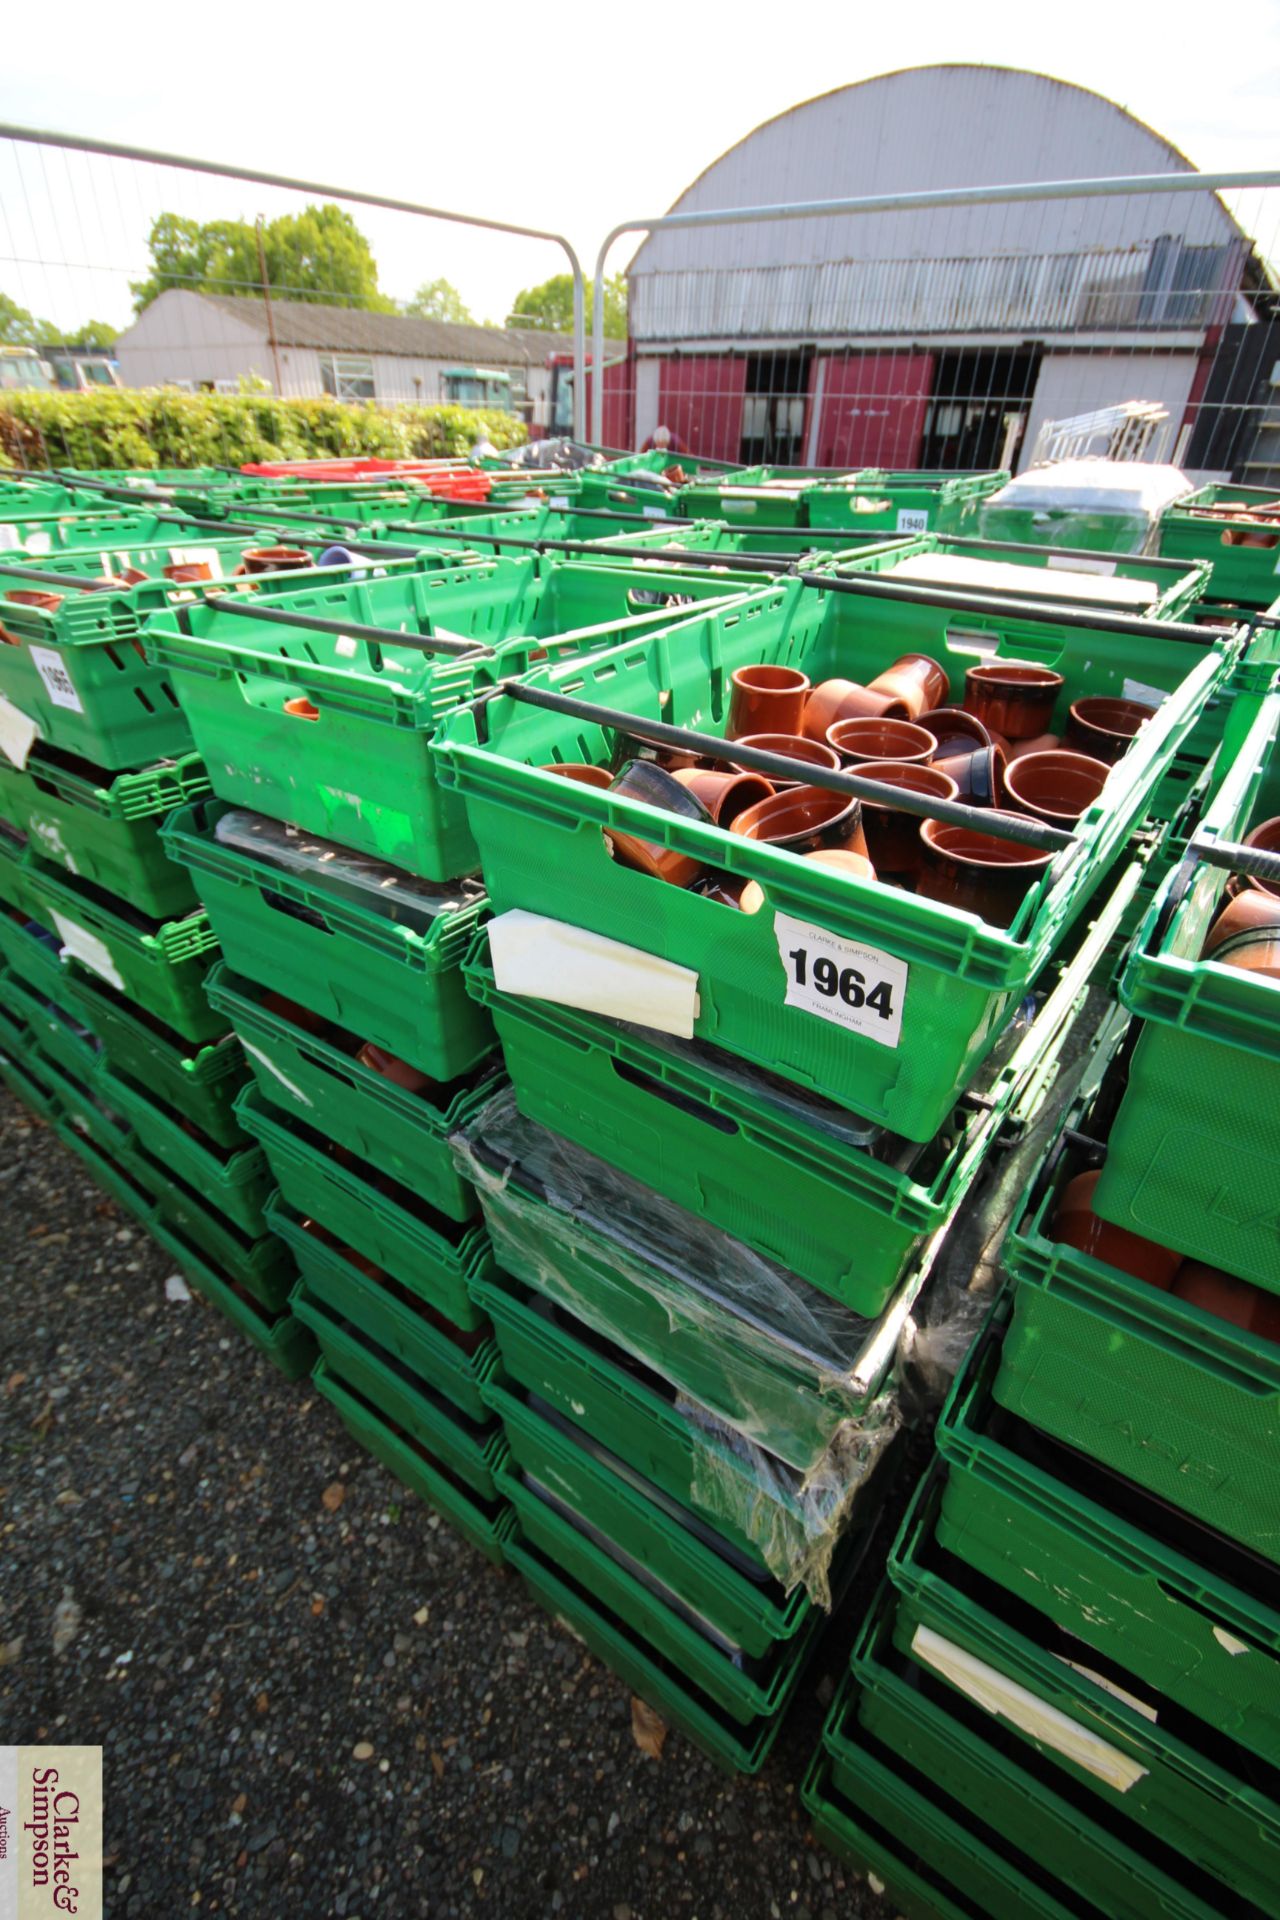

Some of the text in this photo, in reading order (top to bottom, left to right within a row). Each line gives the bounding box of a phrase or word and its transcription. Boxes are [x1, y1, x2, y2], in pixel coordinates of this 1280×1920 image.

[902, 517, 924, 529] 1940
[809, 932, 835, 948] CLARKE
[845, 947, 879, 962] SIMPSON
[789, 948, 894, 1020] 1964
[811, 1001, 863, 1027] FRAMLINGHAM
